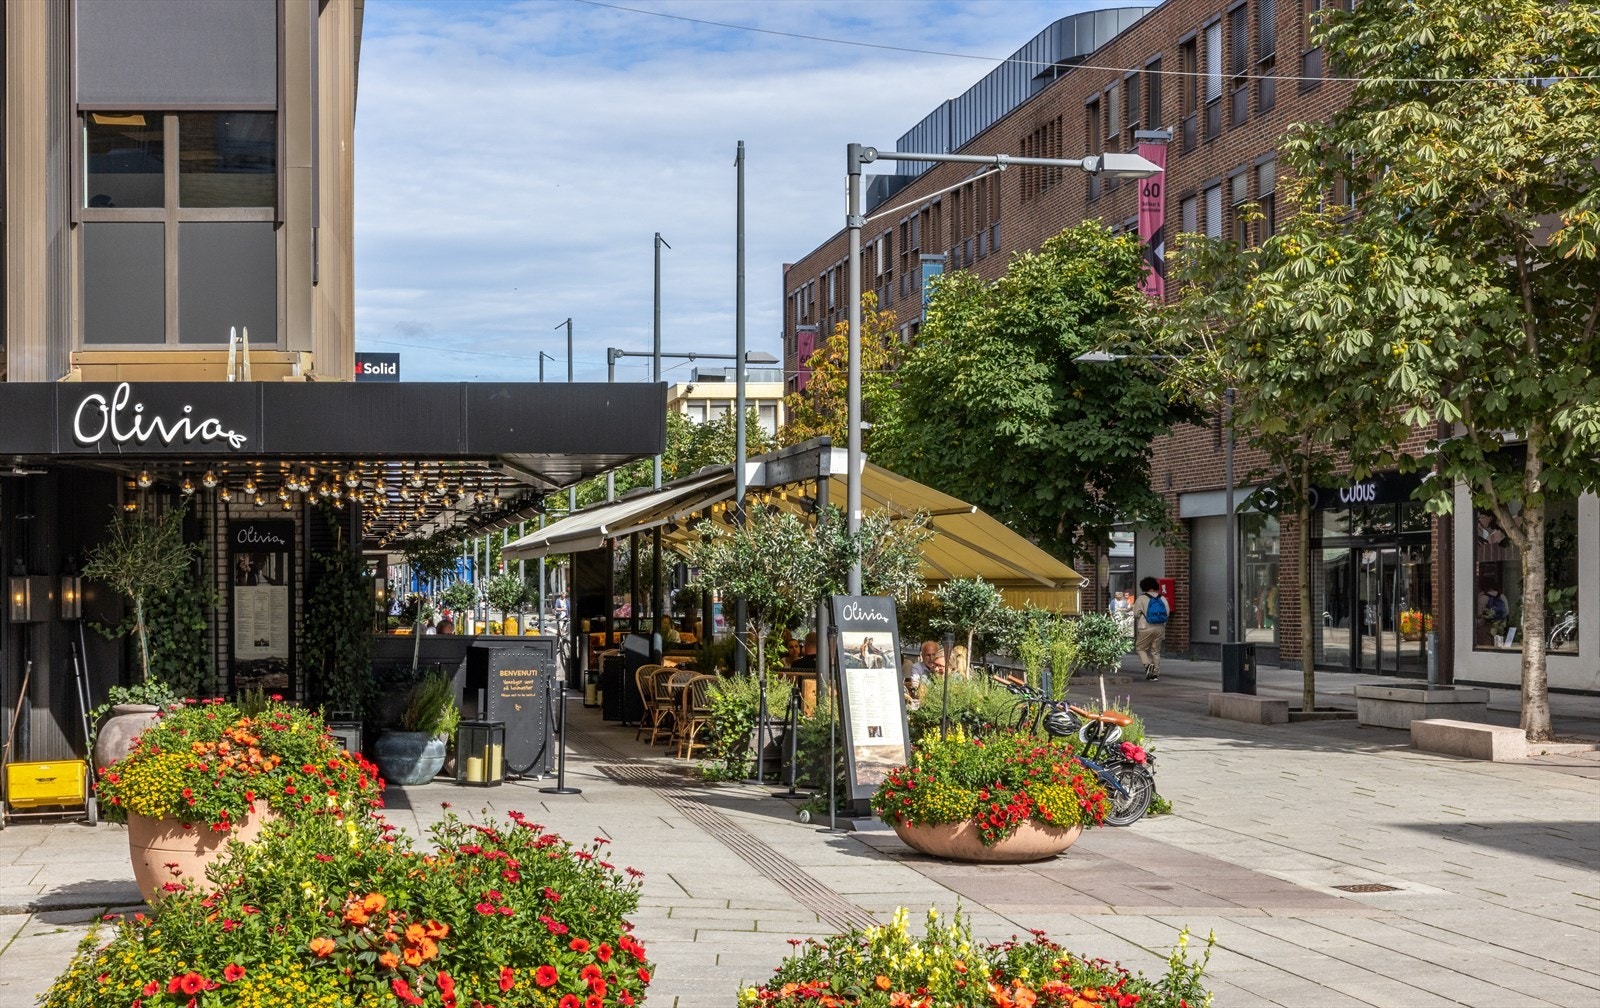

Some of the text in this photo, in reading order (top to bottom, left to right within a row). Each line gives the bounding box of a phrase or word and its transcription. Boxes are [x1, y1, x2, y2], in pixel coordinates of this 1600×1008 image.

[1143, 182, 1160, 198] 60
[363, 362, 396, 375] Solid
[74, 382, 247, 448] Olivia
[1340, 481, 1376, 503] Cubus
[237, 525, 285, 545] Olivia
[842, 601, 889, 623] Olivia
[499, 669, 538, 677] BENVENUTI
